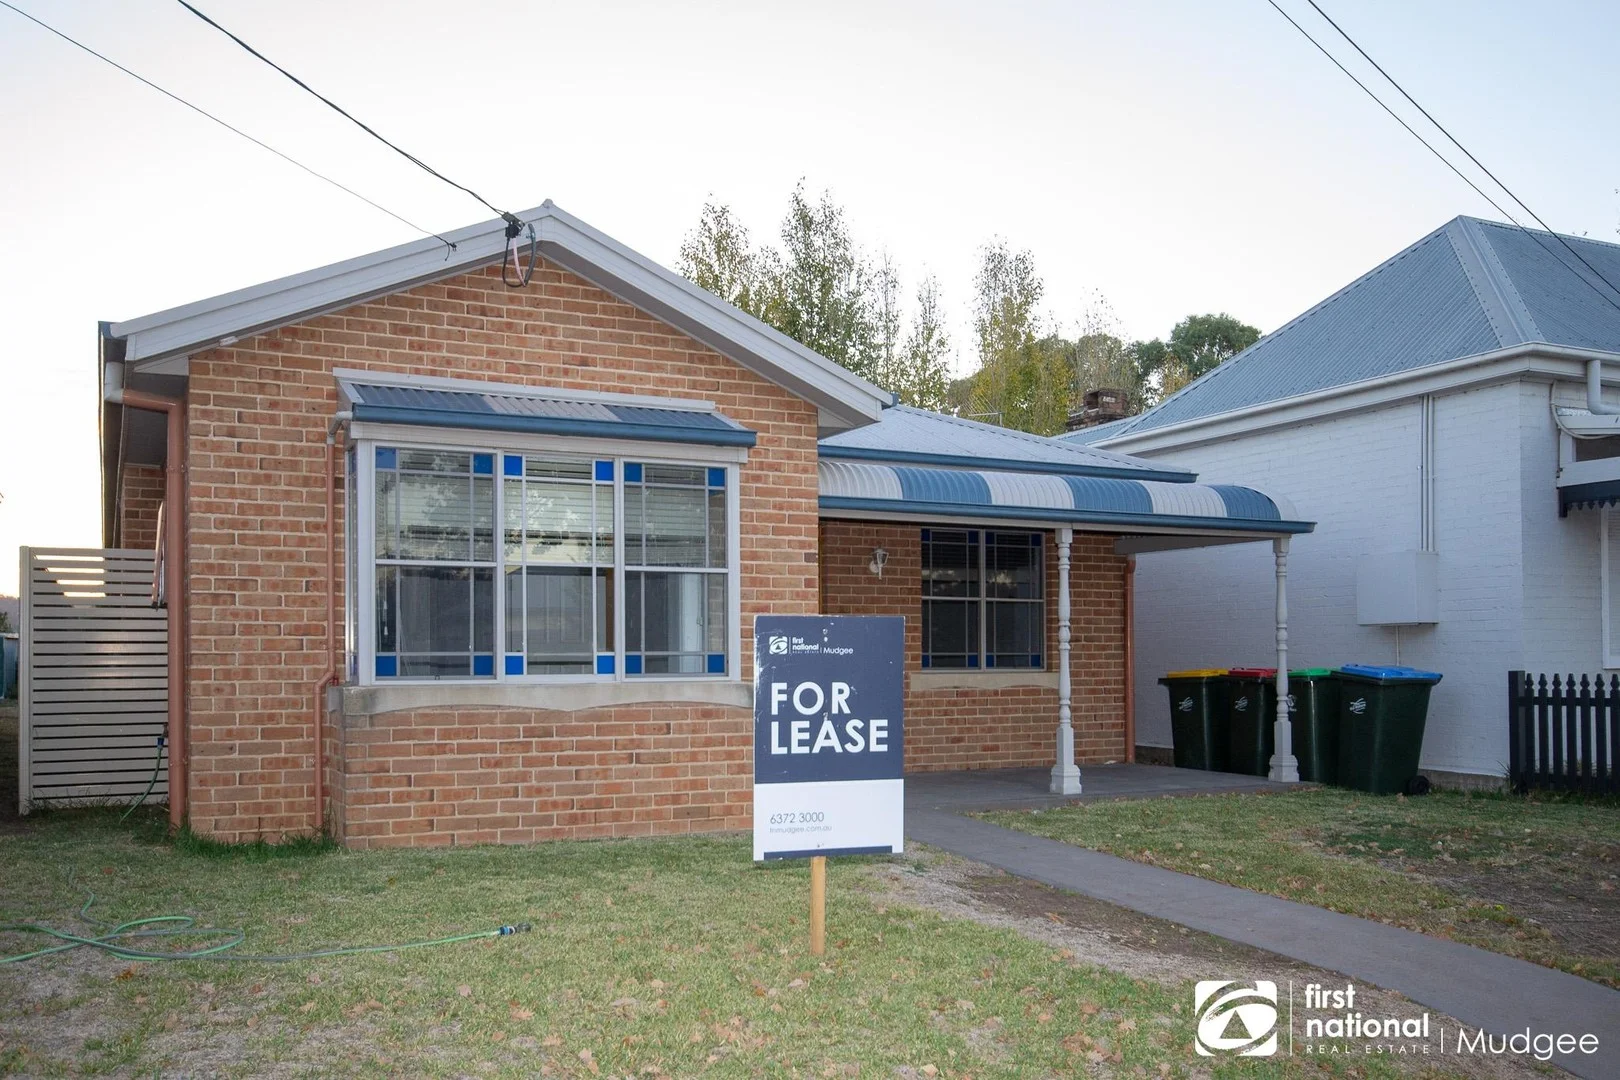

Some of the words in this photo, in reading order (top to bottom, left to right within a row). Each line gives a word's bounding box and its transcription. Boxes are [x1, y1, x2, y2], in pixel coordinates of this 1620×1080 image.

[792, 643, 820, 651] national
[823, 647, 854, 656] Mudgee
[771, 681, 851, 715] FOR
[771, 719, 888, 755] LEASE
[769, 812, 796, 825] 6372
[798, 811, 825, 823] 3000
